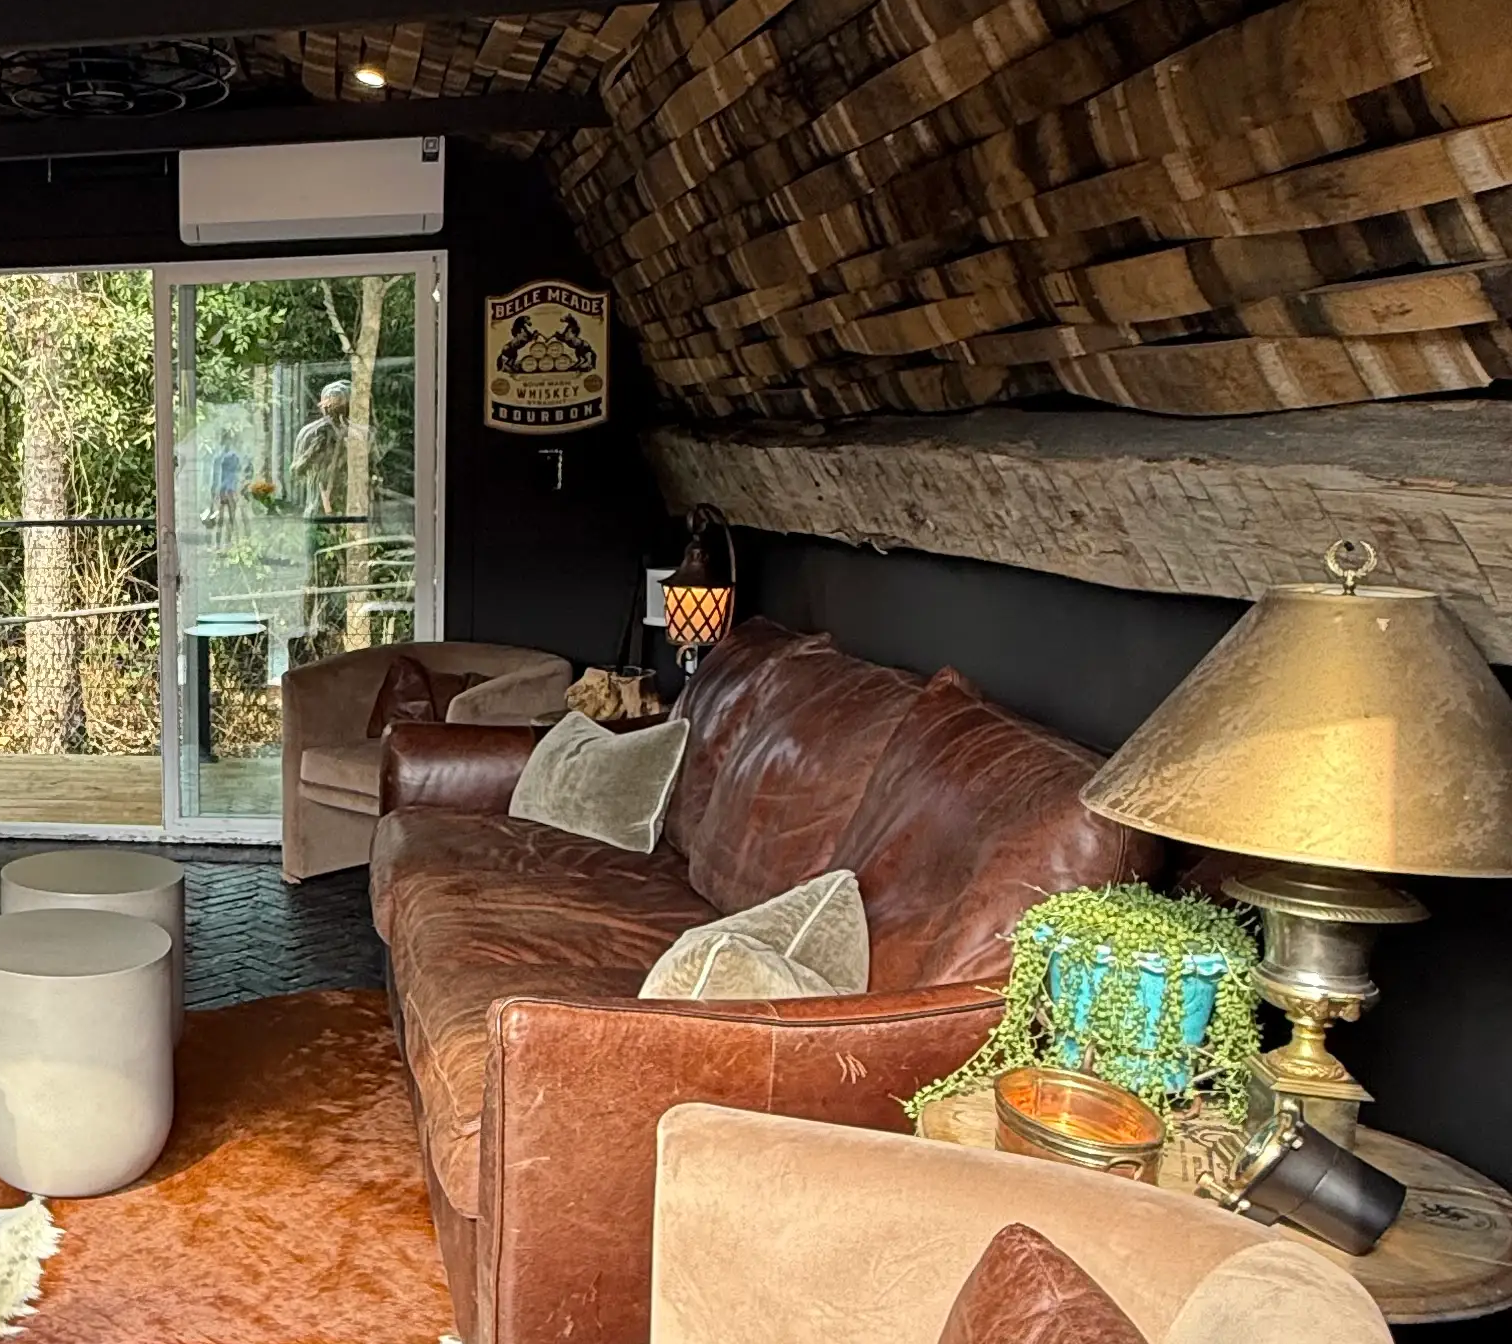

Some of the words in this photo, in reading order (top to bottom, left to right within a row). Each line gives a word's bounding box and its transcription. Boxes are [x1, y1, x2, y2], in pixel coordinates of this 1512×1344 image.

[495, 290, 541, 318] BELLE
[547, 288, 601, 313] MEADE
[516, 385, 579, 399] WHISKEY
[498, 403, 593, 423] BOURBON
